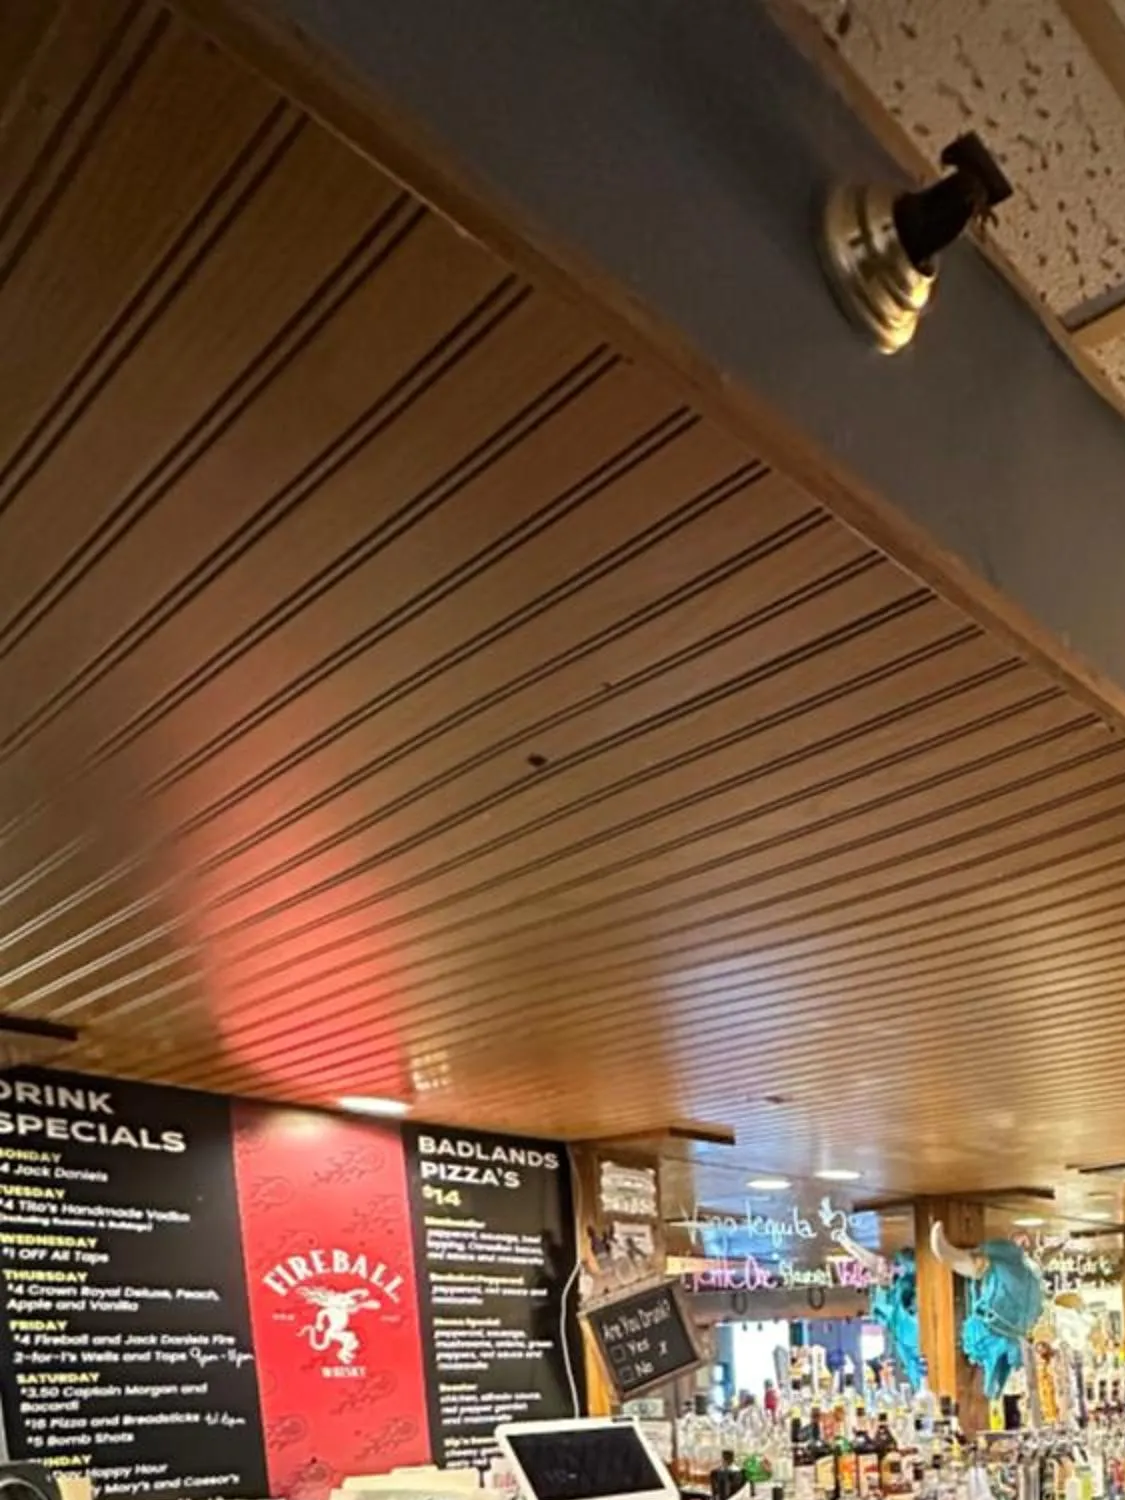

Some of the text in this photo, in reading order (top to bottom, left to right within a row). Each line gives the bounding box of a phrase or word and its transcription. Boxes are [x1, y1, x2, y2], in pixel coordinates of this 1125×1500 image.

[418, 1135, 560, 1170] BADLANDS
[13, 1163, 50, 1177] Jack
[420, 1161, 521, 1188] PIZZA'S
[422, 1184, 461, 1206] $14
[61, 1203, 143, 1219] Handmade
[0, 1232, 98, 1248] WEDNESDAY
[18, 1248, 48, 1260] OFF
[3, 1269, 88, 1283] THURSDAY
[263, 1248, 404, 1304] FIREBALL
[27, 1284, 77, 1297] Crown
[80, 1286, 121, 1300] Royal
[55, 1299, 85, 1311] and
[9, 1319, 67, 1331] FRIDAY
[34, 1333, 90, 1345] Fireball
[92, 1334, 121, 1345] and
[124, 1334, 157, 1346] Jack
[123, 1350, 150, 1362] and
[16, 1372, 100, 1384] SATURDAY
[124, 1385, 178, 1398] Morgan
[180, 1383, 208, 1395] and
[90, 1415, 119, 1427] and
[30, 1454, 92, 1468] UNDAY
[135, 1463, 169, 1475] Hour
[153, 1478, 181, 1490] and
